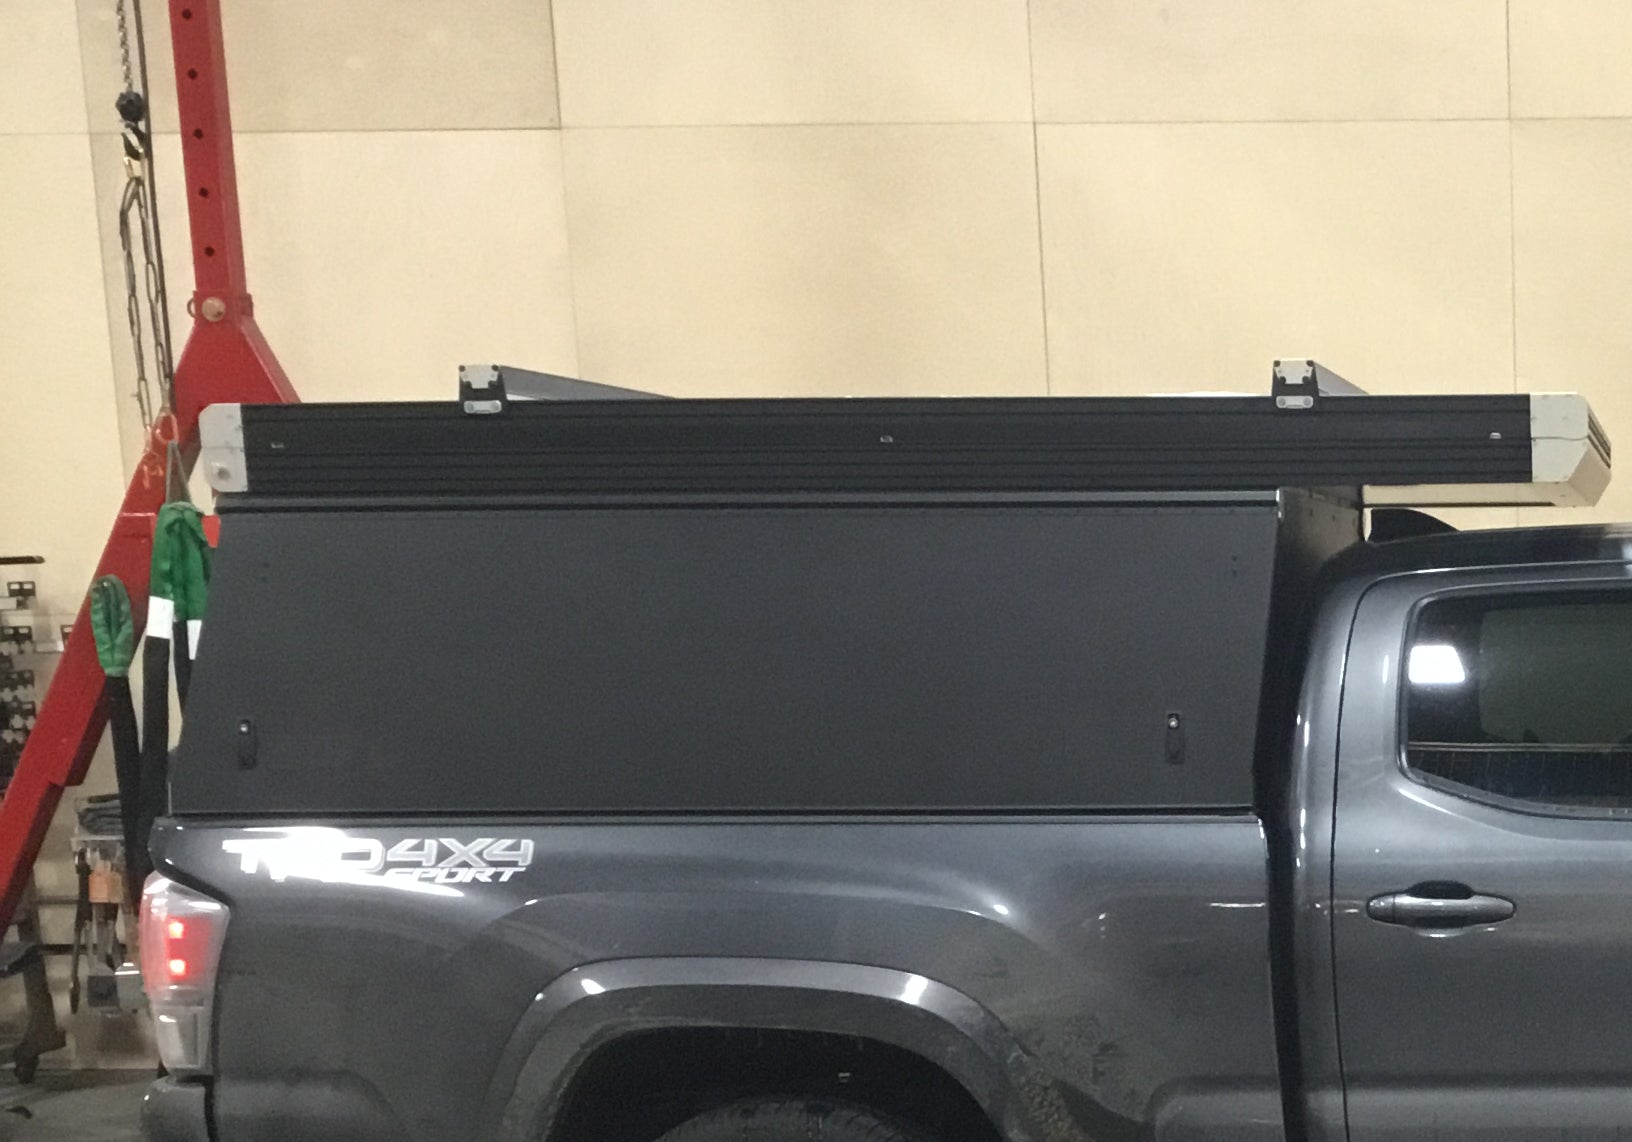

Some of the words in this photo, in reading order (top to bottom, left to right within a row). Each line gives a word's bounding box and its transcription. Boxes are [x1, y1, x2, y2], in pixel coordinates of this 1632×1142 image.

[222, 837, 386, 876] TD
[386, 838, 535, 867] 4X4
[384, 866, 527, 884] SPORT
